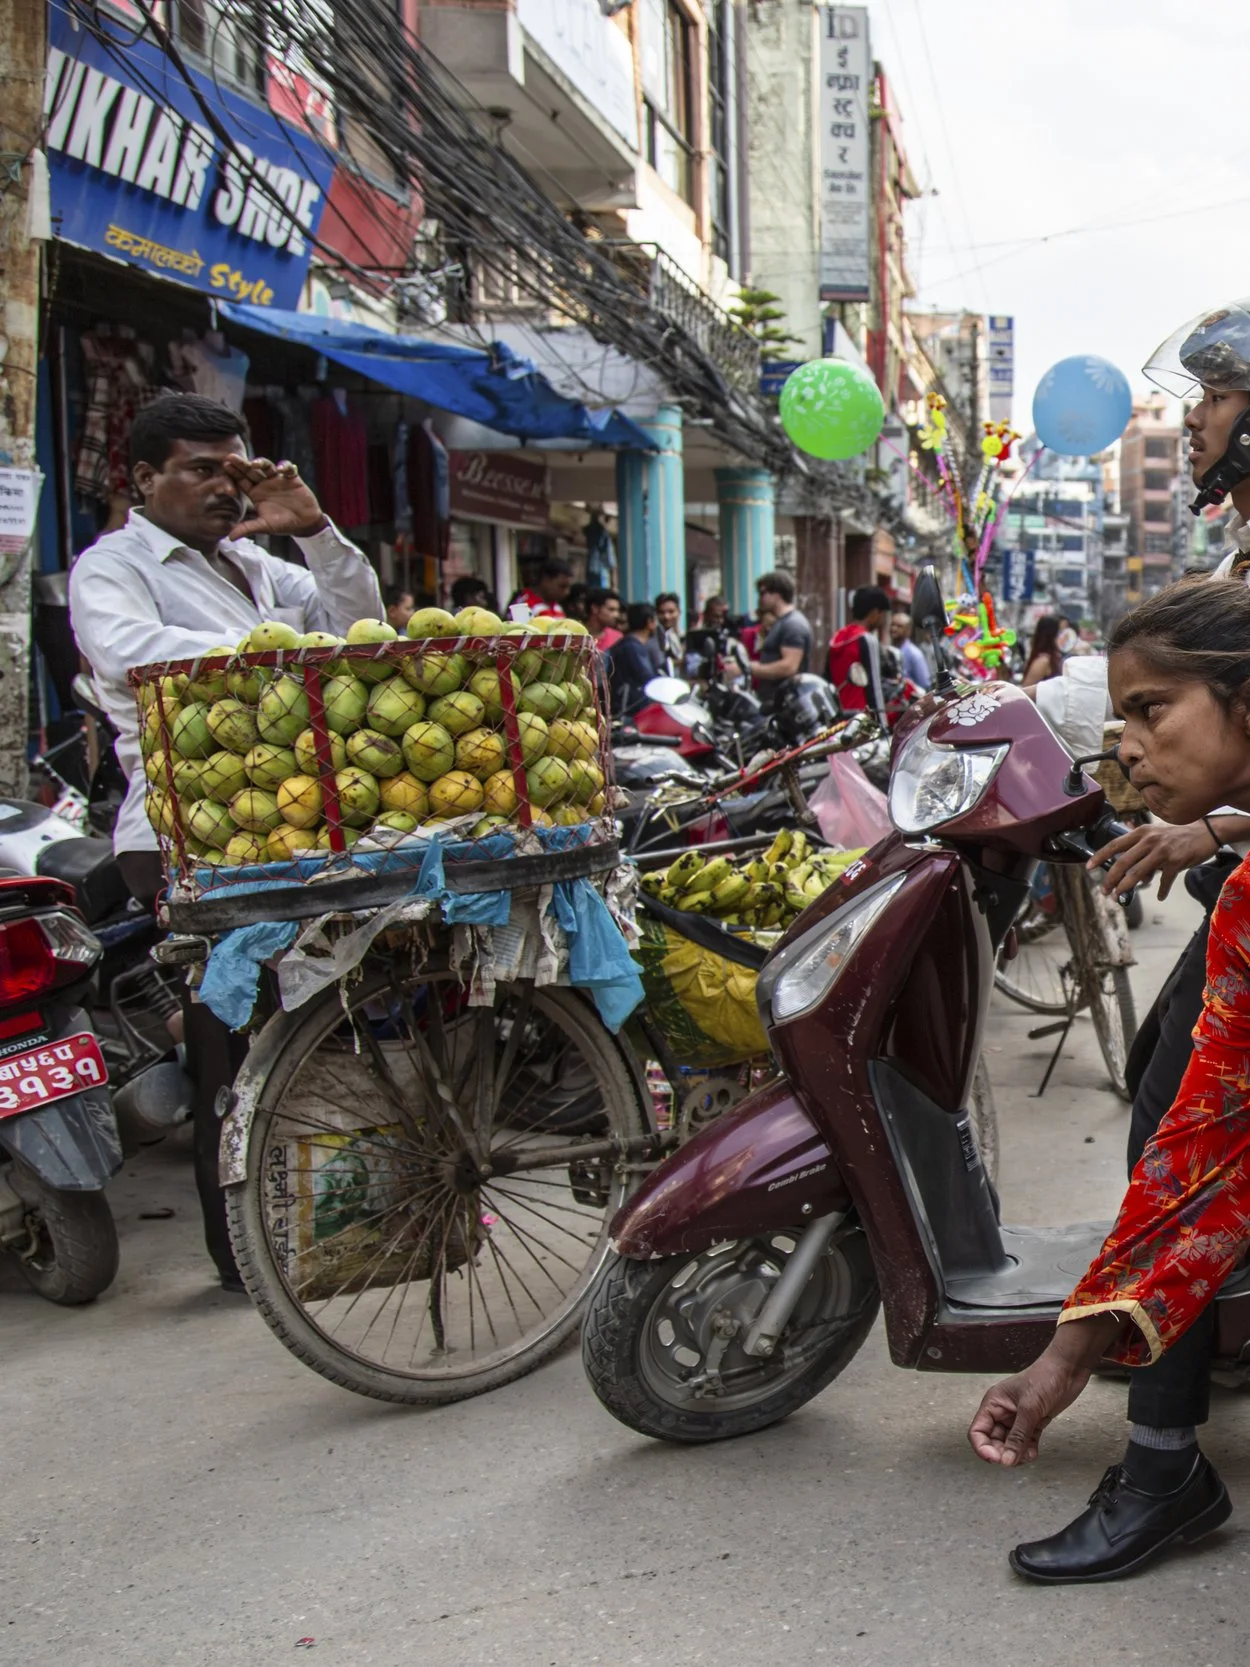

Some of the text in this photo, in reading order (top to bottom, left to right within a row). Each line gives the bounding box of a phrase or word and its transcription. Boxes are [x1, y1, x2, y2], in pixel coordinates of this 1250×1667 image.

[214, 141, 320, 257] SHOE
[210, 263, 275, 305] Style
[0, 1035, 48, 1056] HONDA
[768, 1163, 826, 1192] Combi Brake
